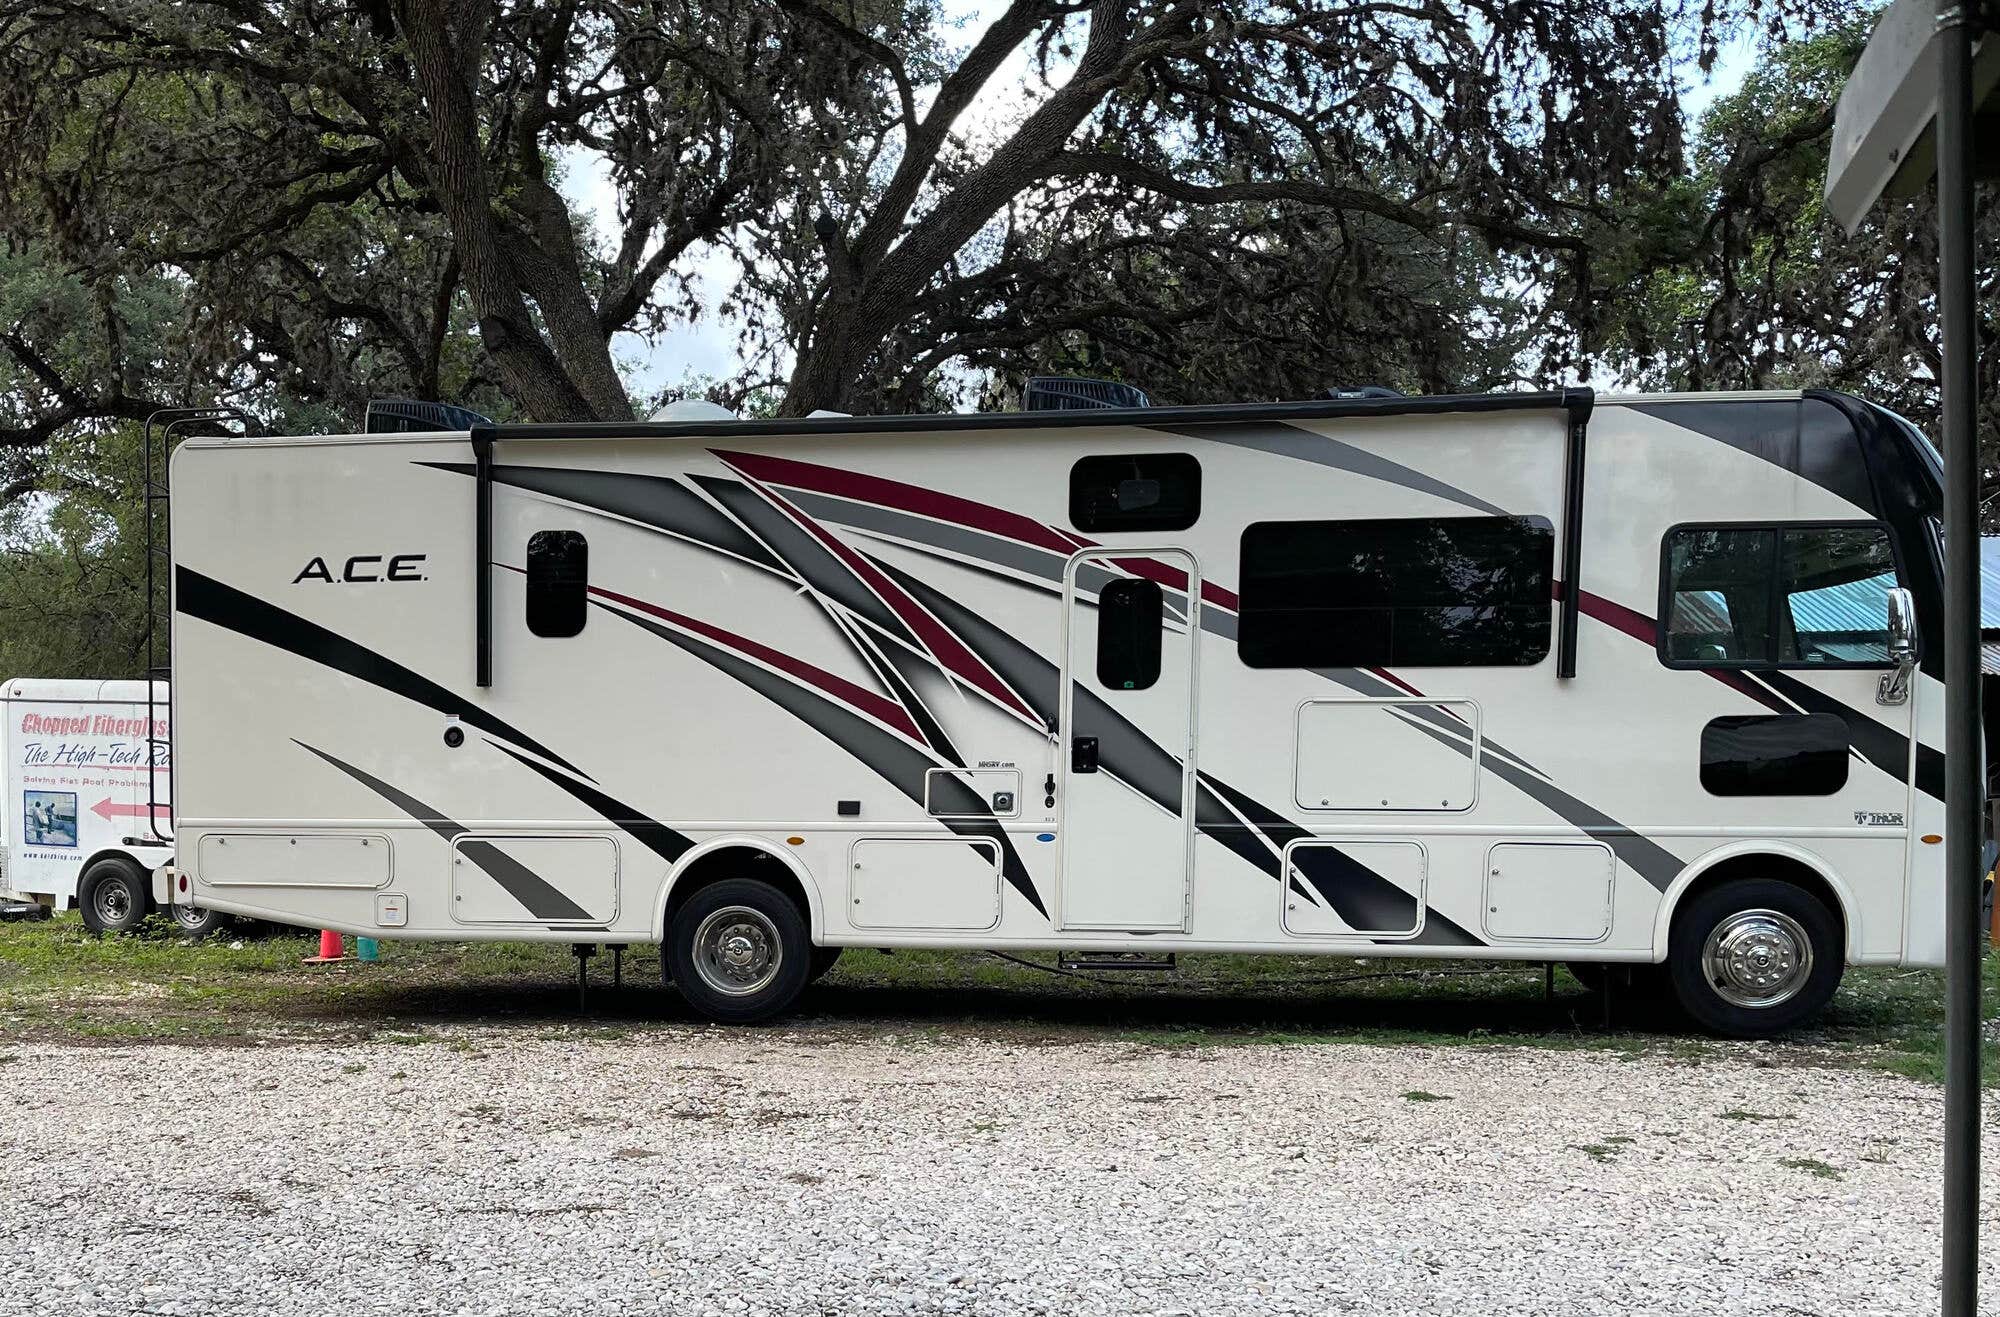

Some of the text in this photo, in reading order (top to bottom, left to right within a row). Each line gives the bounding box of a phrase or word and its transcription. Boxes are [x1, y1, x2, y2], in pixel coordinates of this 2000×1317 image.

[291, 554, 429, 584] A.C.E.
[21, 713, 170, 738] Chopped Fibergls
[24, 743, 48, 765] The
[23, 775, 56, 785] Solving
[60, 776, 78, 785] Flat
[82, 777, 105, 787] Roof
